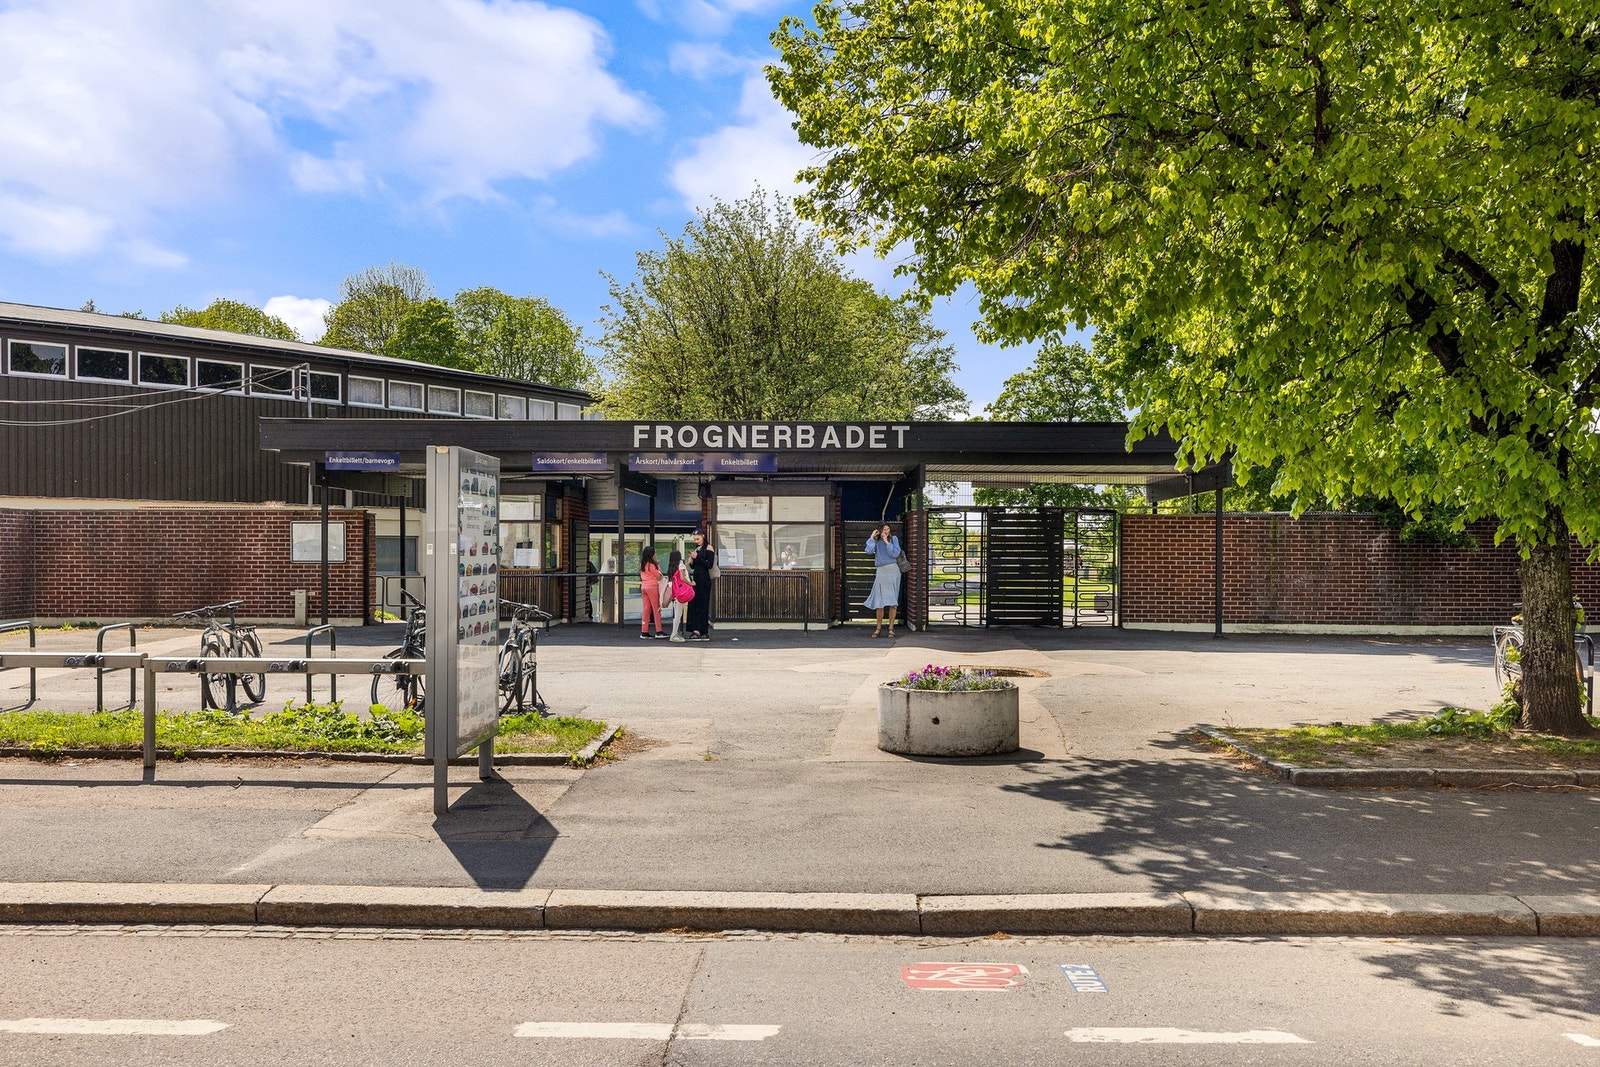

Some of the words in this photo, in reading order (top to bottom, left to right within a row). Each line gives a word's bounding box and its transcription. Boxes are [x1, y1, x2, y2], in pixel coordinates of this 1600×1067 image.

[633, 425, 911, 449] FROGNERBADET
[328, 456, 395, 466] Enkeltbillett/barnevogn
[536, 457, 602, 466] Saldokort/enkeltbillett
[635, 456, 696, 466] Årskort/halvårskort
[720, 458, 759, 466] Enkeltbillett
[1065, 970, 1107, 992] RUTE
